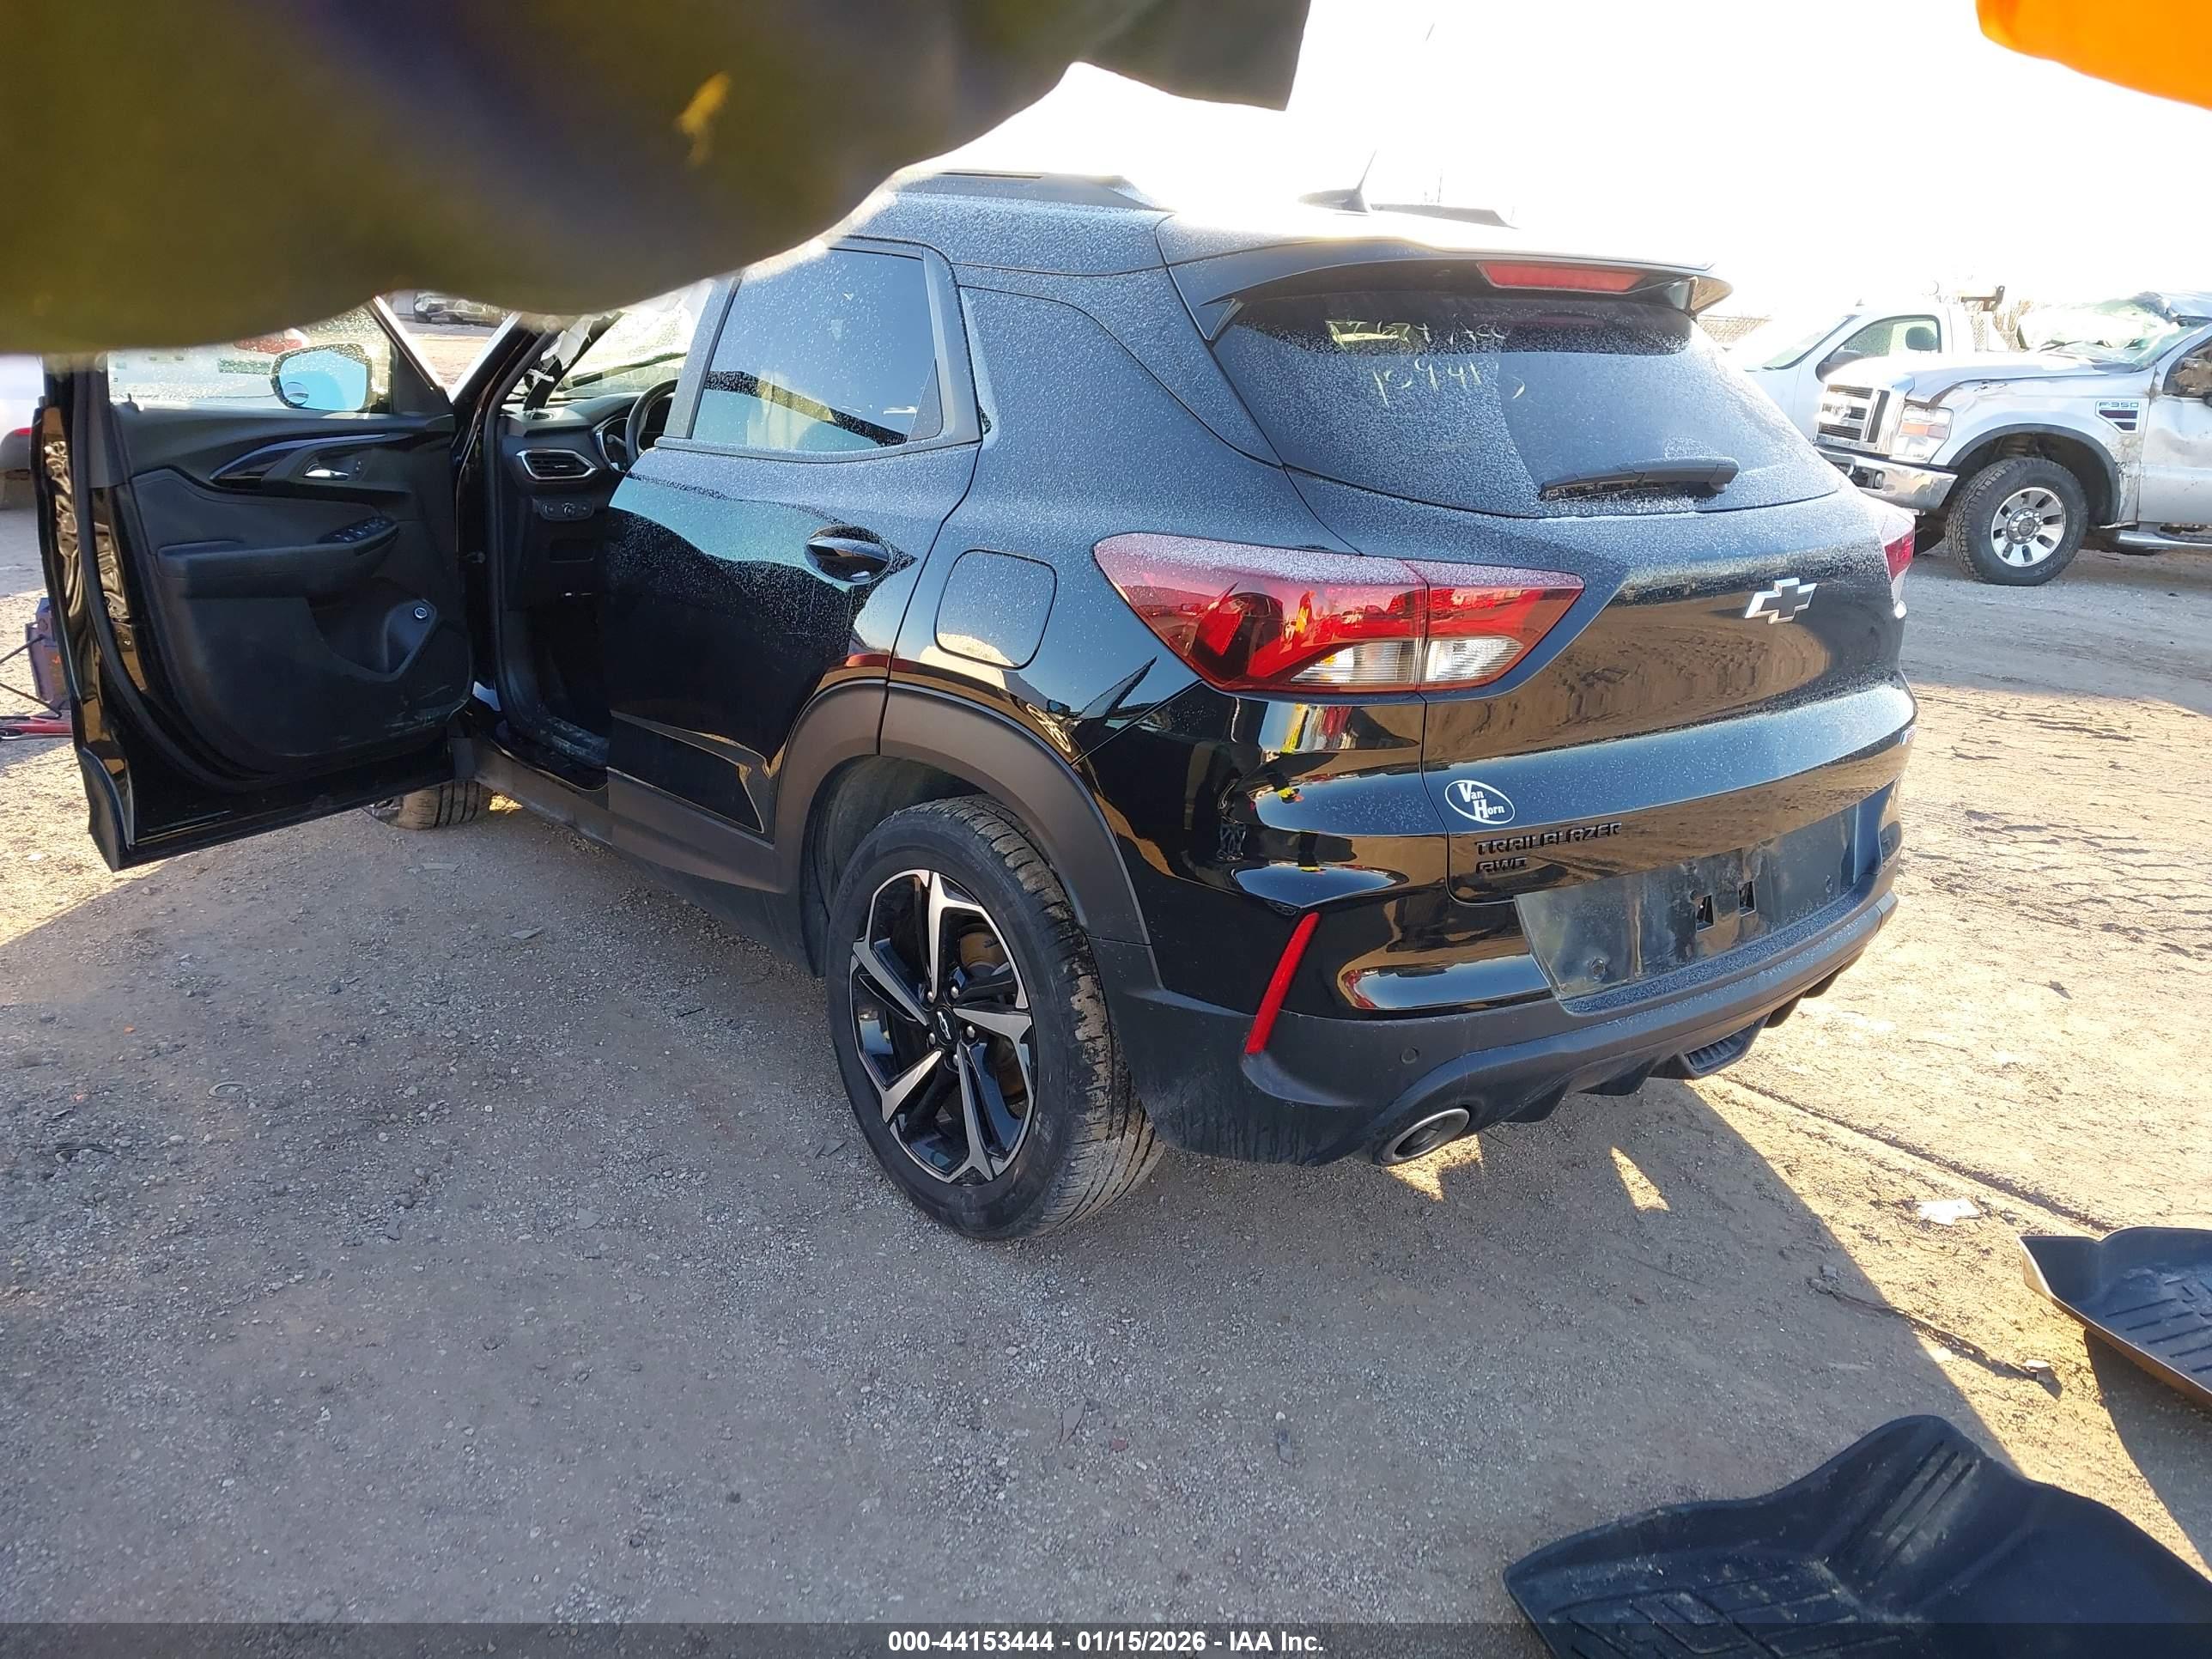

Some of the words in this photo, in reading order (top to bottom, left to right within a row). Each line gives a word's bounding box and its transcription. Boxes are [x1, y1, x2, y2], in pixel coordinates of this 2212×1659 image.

[1457, 783, 1484, 802] Van
[1473, 799, 1505, 819] Horn
[1475, 822, 1622, 855] TRAILBLAZER
[1476, 858, 1528, 874] AWD
